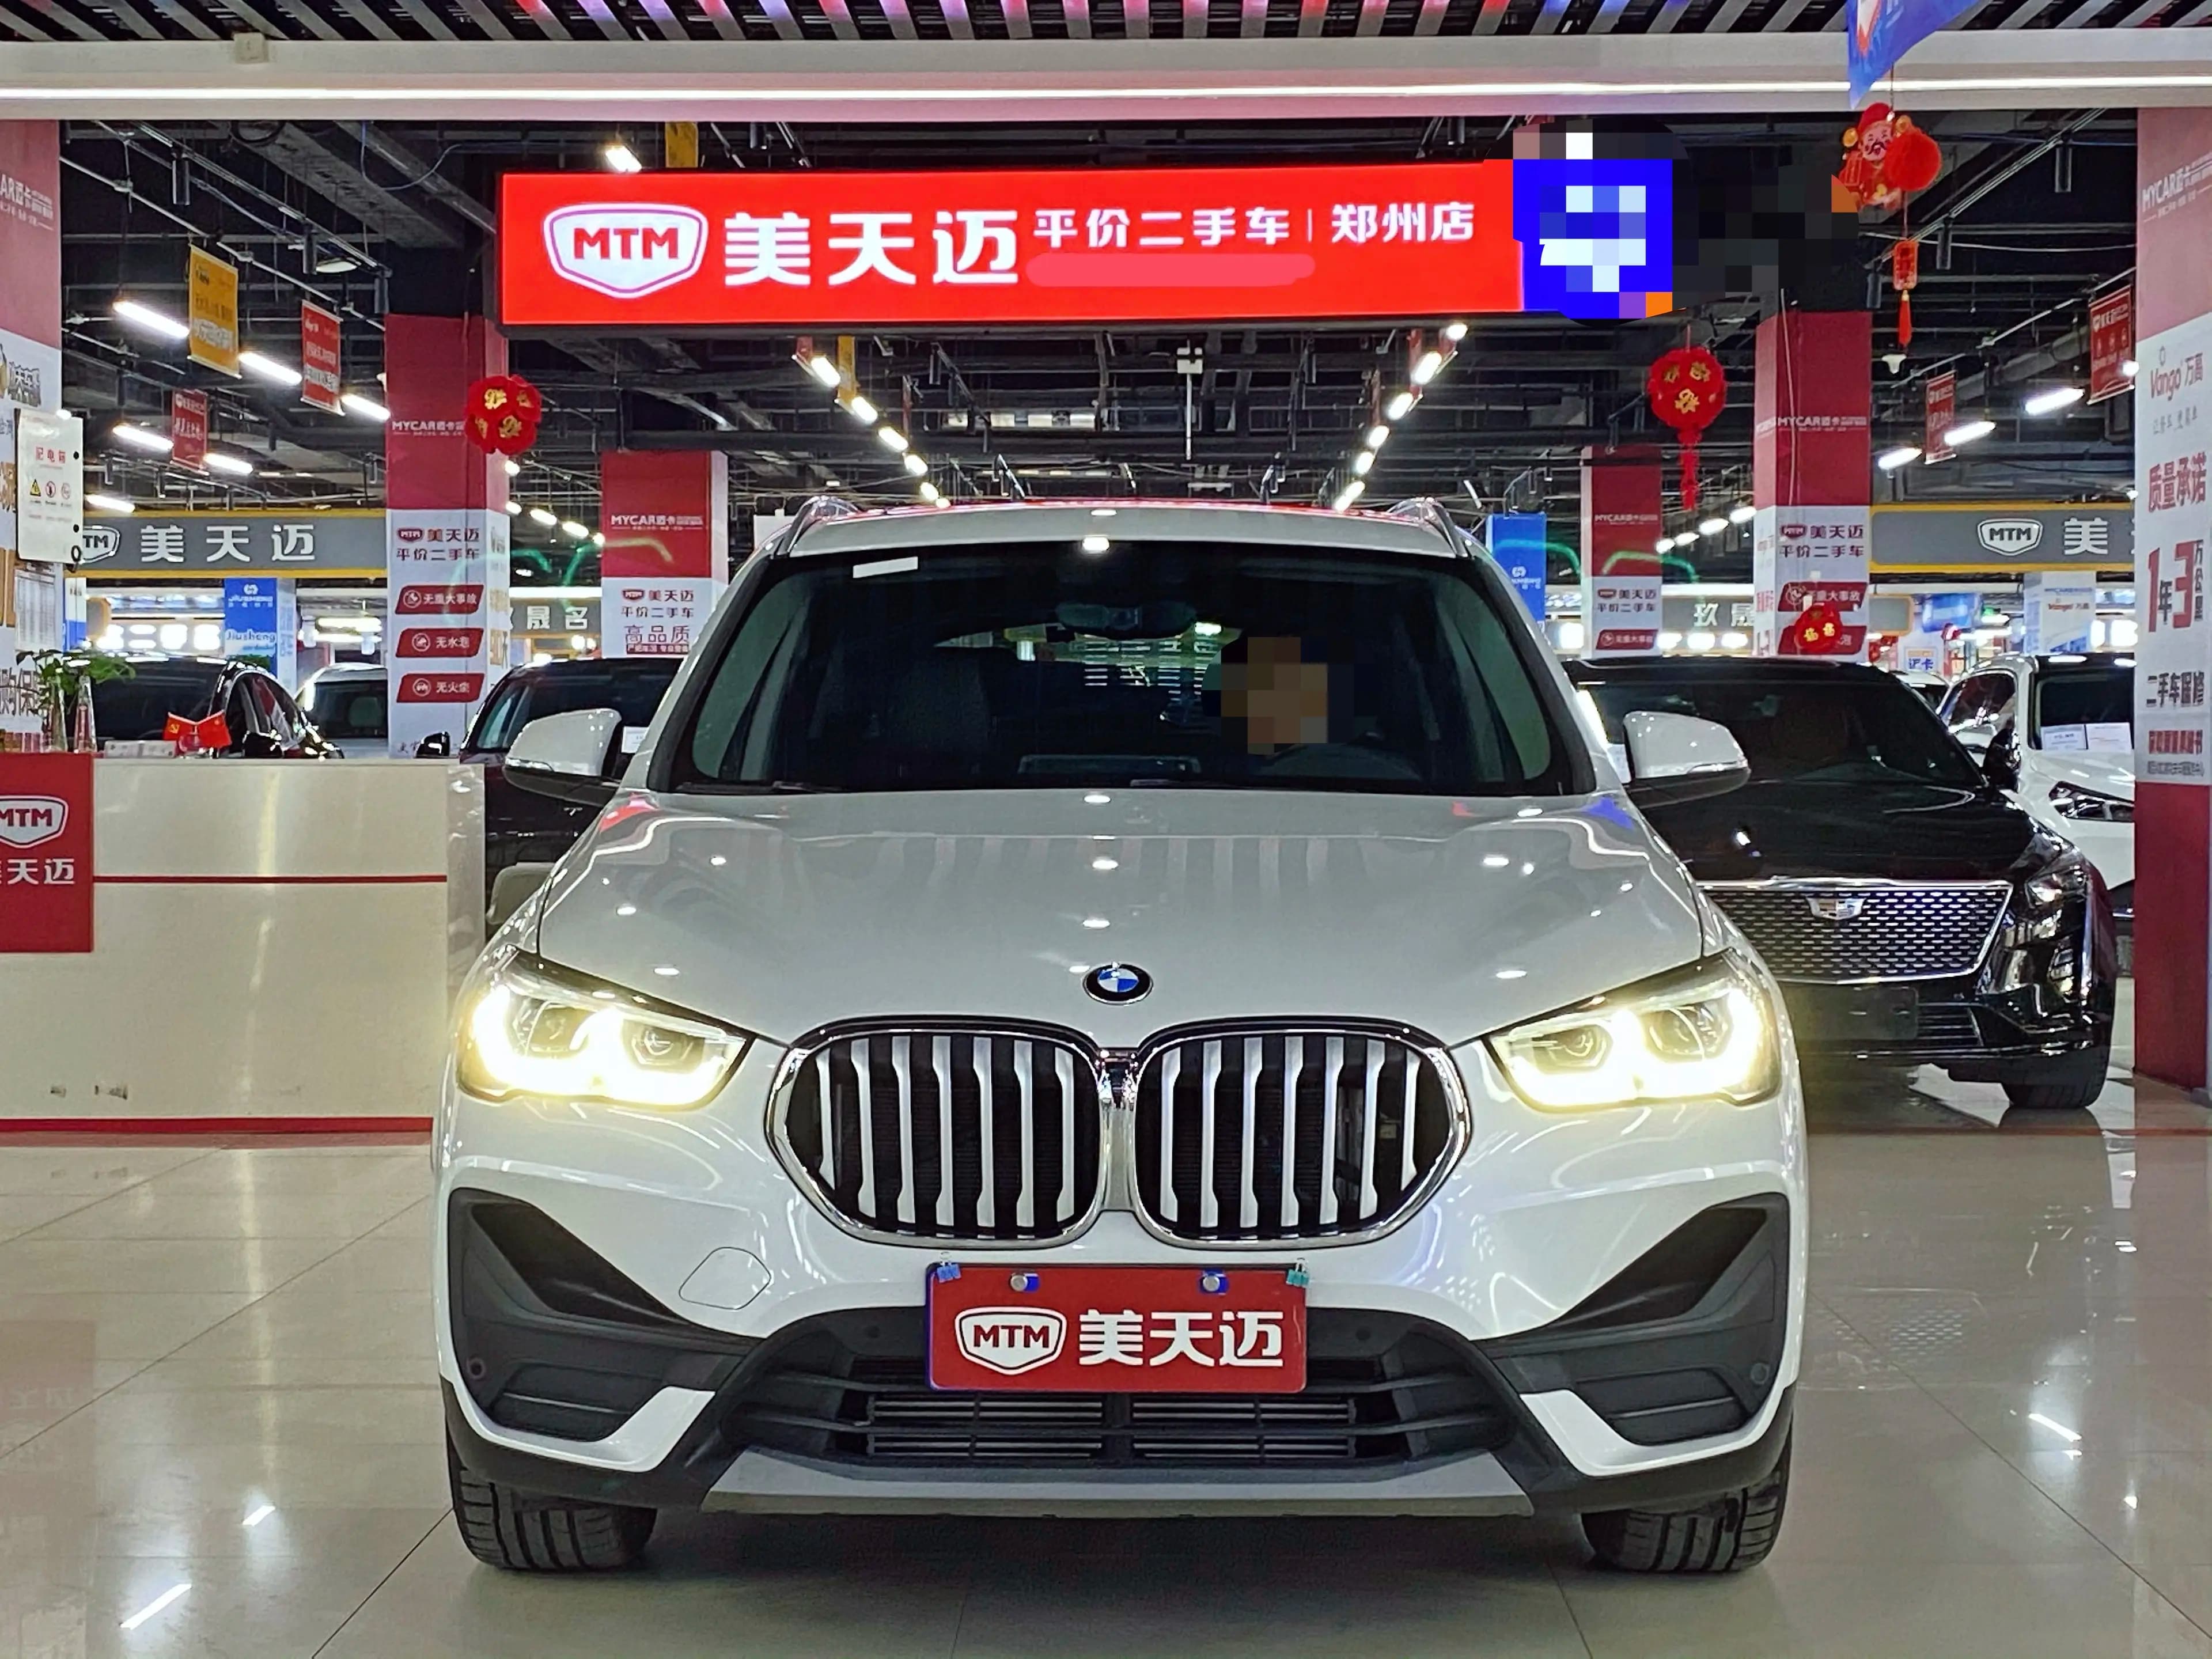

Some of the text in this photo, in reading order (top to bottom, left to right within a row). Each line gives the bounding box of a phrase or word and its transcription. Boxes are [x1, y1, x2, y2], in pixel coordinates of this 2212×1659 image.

[1033, 202, 1475, 248] 平价二手车 郑州店
[574, 228, 679, 259] MTM
[725, 210, 1018, 286] 美天迈
[2148, 451, 2207, 513] 质量承诺
[82, 535, 108, 548] TM
[427, 528, 479, 542] 美天迈
[1810, 525, 1864, 539] 美天迈
[1989, 527, 2032, 541] MTM
[2064, 517, 2134, 555] 美
[140, 524, 315, 563] 美天迈
[1779, 544, 1864, 558] 平价二手车
[396, 547, 480, 562] 平价二手车
[423, 593, 477, 605] 无重大事故
[649, 589, 694, 603] 美天迈
[510, 607, 588, 630] 晟名
[621, 606, 694, 618] 平价二手车
[624, 625, 690, 645] 高品质
[0, 858, 75, 885] 天迈
[973, 1324, 1050, 1349] MTM
[1079, 1309, 1284, 1367] 美天迈
